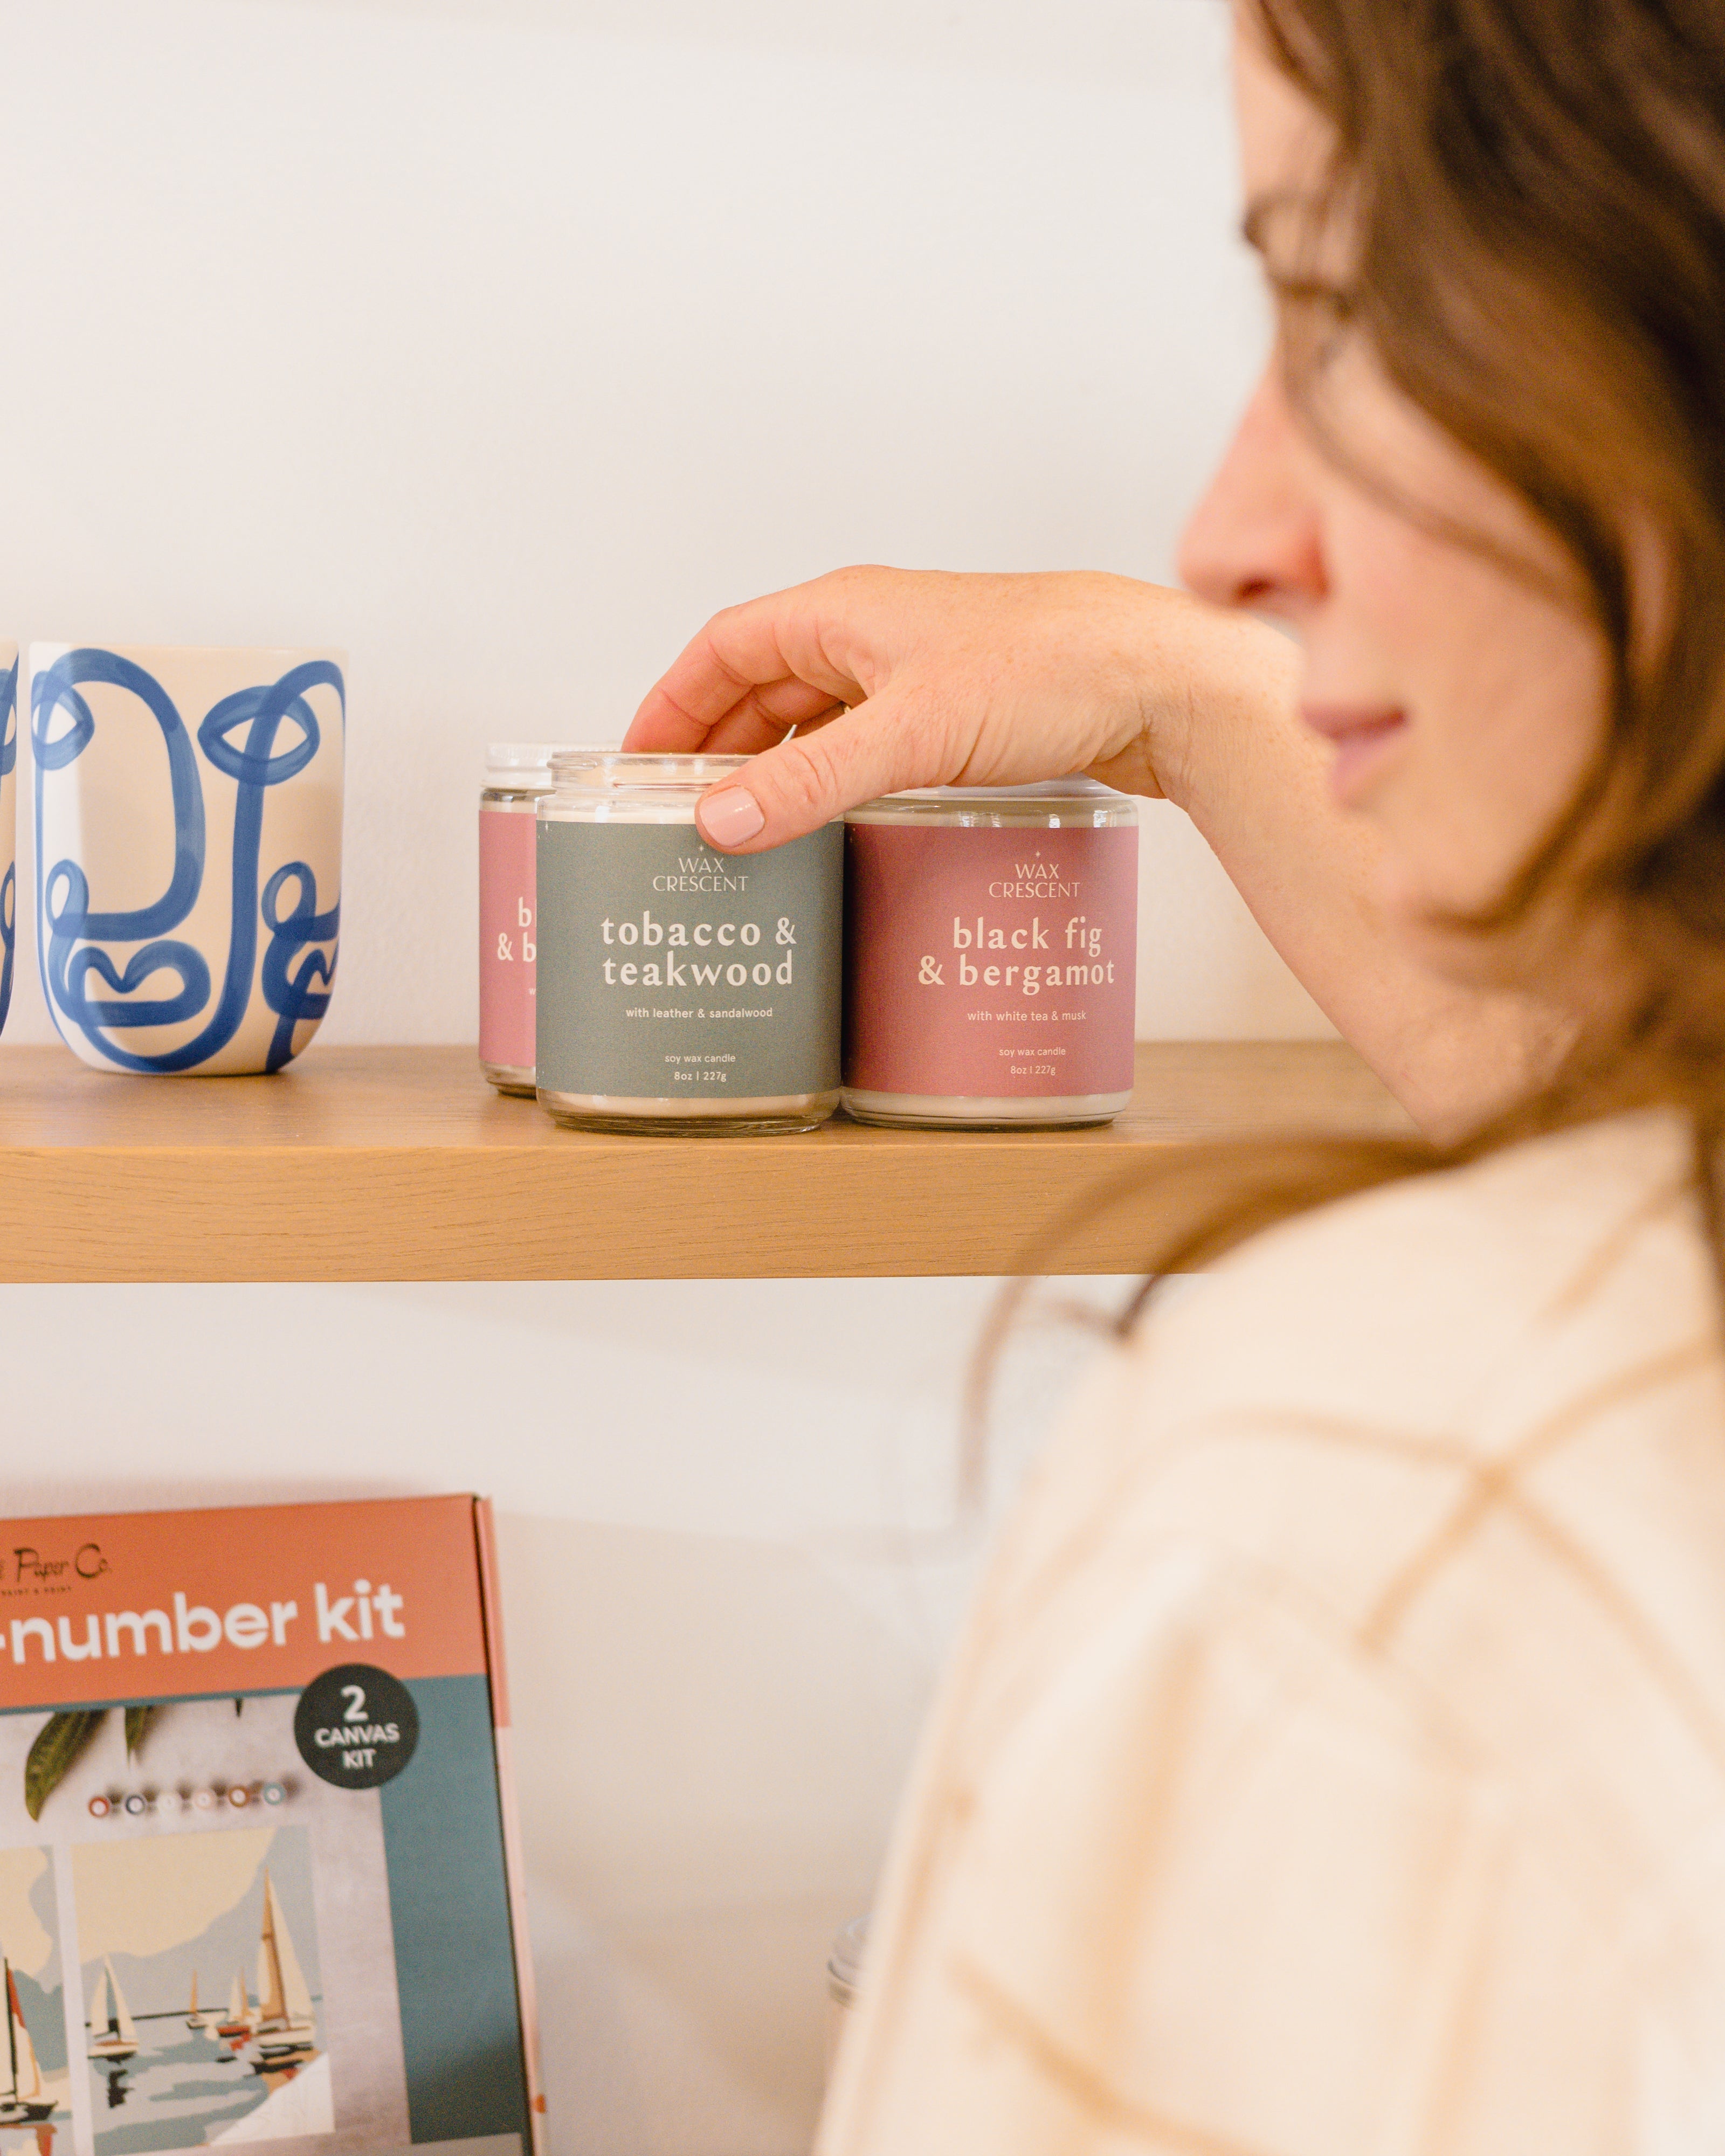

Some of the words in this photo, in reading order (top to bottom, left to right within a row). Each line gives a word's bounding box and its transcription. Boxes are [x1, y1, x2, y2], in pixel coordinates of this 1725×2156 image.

[678, 857, 724, 873] WAX
[1015, 863, 1059, 879] WAX
[652, 875, 749, 892] CRESCENT
[989, 882, 1080, 898] CRESCENT
[601, 910, 761, 946] tobacco
[775, 917, 797, 945] &
[953, 916, 1050, 949] black
[1065, 916, 1102, 957] fig
[498, 932, 514, 961] &
[602, 949, 792, 986] teakwood
[918, 955, 946, 985] &
[960, 953, 1115, 996] bergamot
[626, 1007, 649, 1018] with
[653, 1008, 694, 1018] leather
[698, 1008, 705, 1018] &
[709, 1007, 773, 1018] sandalwood
[968, 1011, 992, 1021] with
[996, 1011, 1027, 1021] white
[1031, 1011, 1048, 1021] tea
[1051, 1011, 1058, 1020] &
[1062, 1010, 1086, 1020] musk
[665, 1055, 681, 1065] soy
[705, 1054, 736, 1062] candle
[999, 1049, 1015, 1058] soy
[1037, 1047, 1066, 1056] candle
[674, 1072, 693, 1081] 8oz
[703, 1071, 727, 1082] 227g
[1010, 1066, 1027, 1074] 8oz
[1035, 1066, 1055, 1076] 227g
[0, 1591, 298, 1664] number
[314, 1578, 405, 1643] kit
[340, 1684, 368, 1722] 2
[314, 1722, 400, 1748] CANVAS
[343, 1749, 377, 1770] KIT
